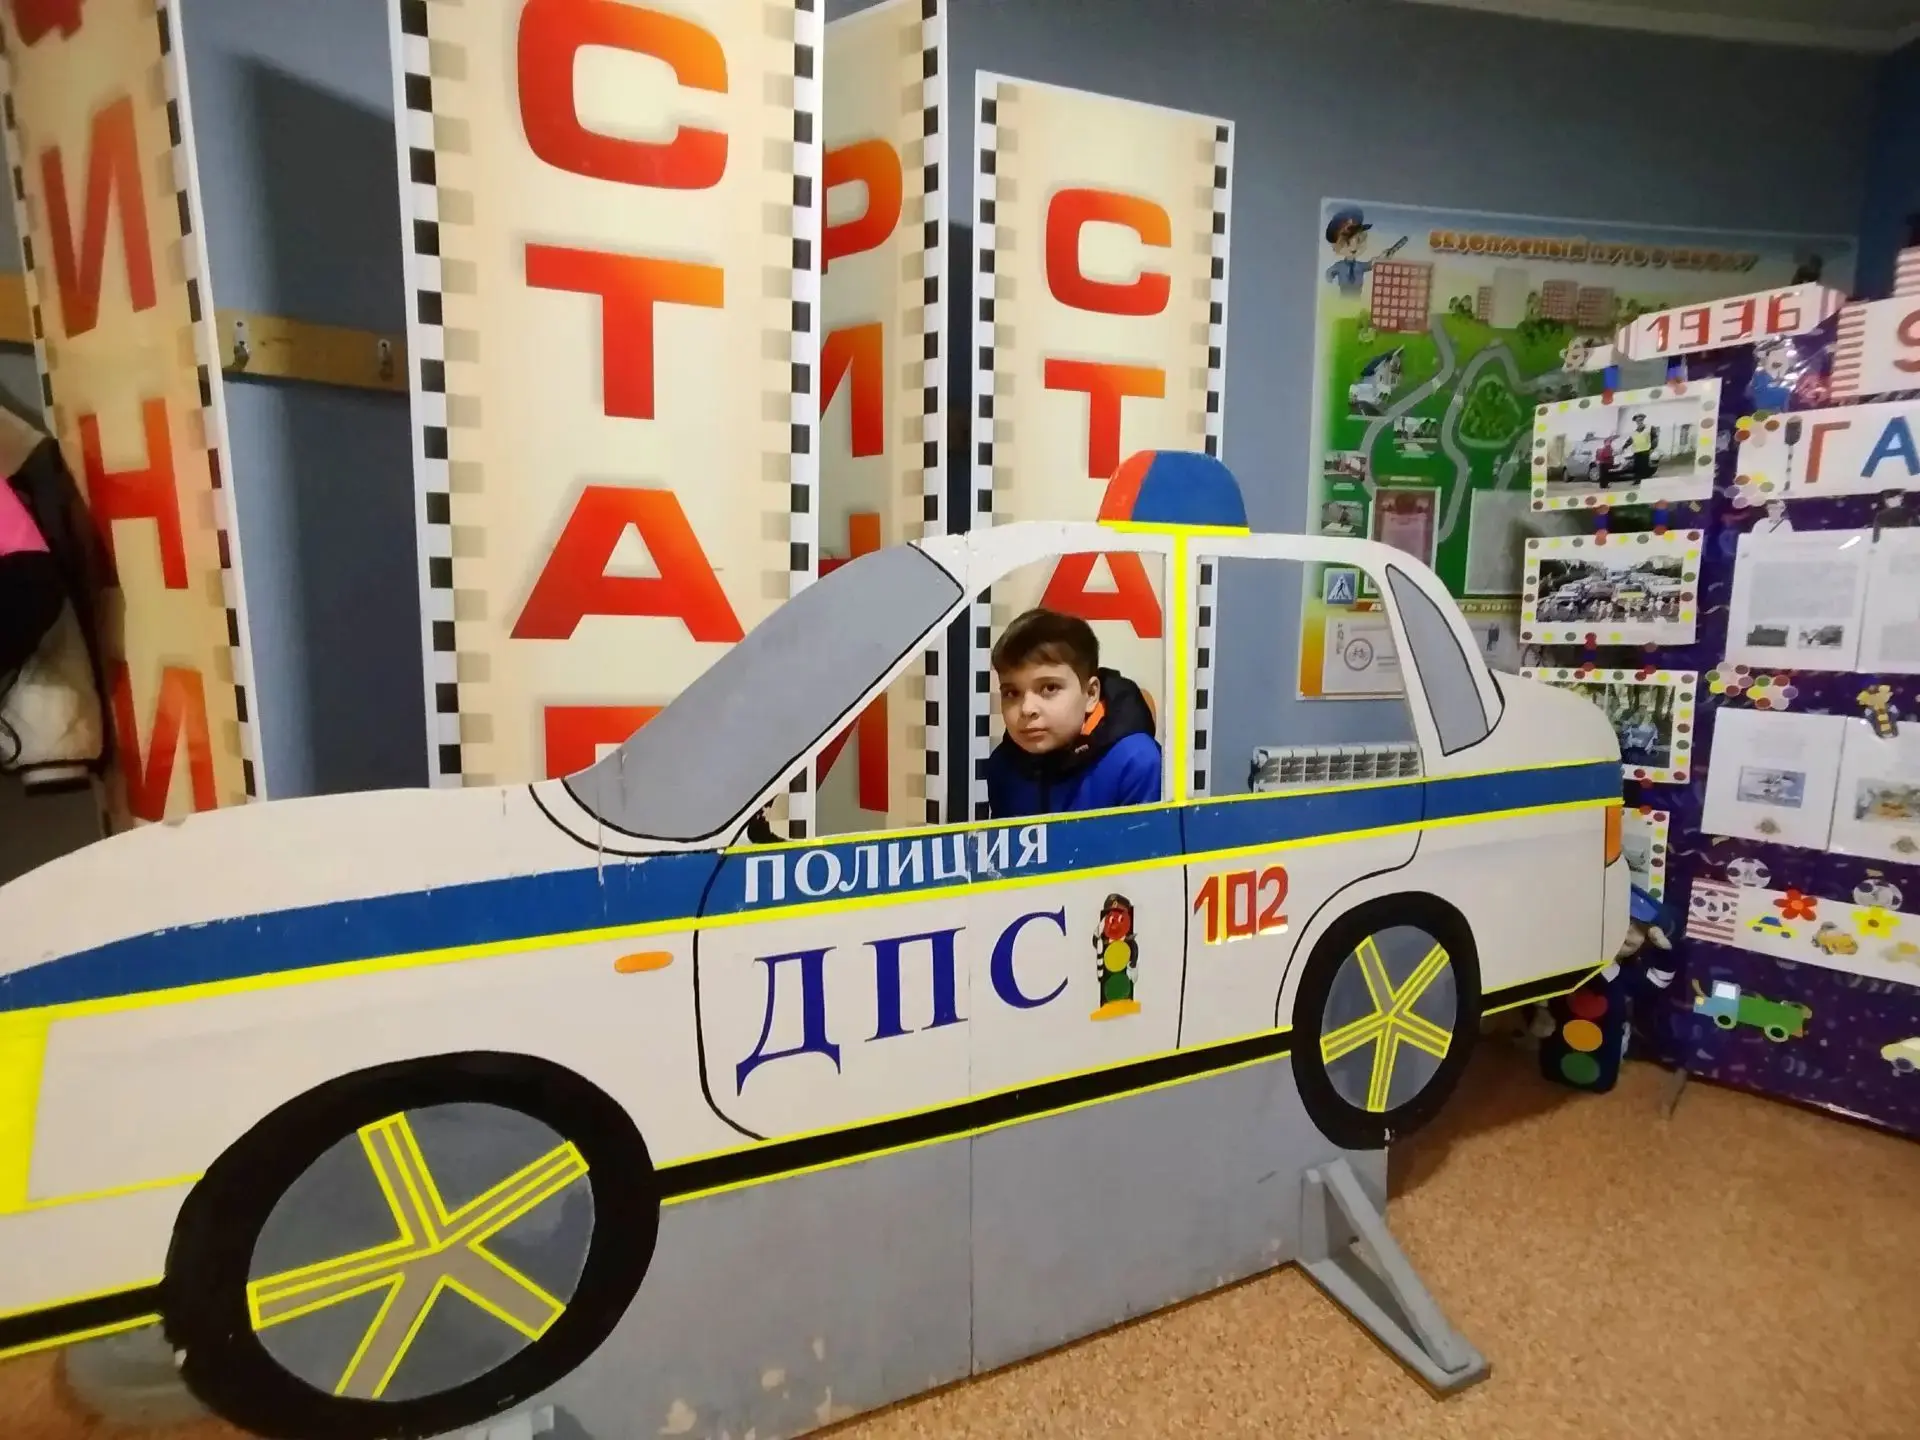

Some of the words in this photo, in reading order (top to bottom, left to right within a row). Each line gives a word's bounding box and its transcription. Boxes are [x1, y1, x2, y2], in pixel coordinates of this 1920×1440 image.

[1646, 292, 1801, 352] 1936
[745, 824, 1048, 902] ПОЛИЦИЯ
[1194, 866, 1289, 944] 102
[736, 905, 1069, 1097] ДПС
